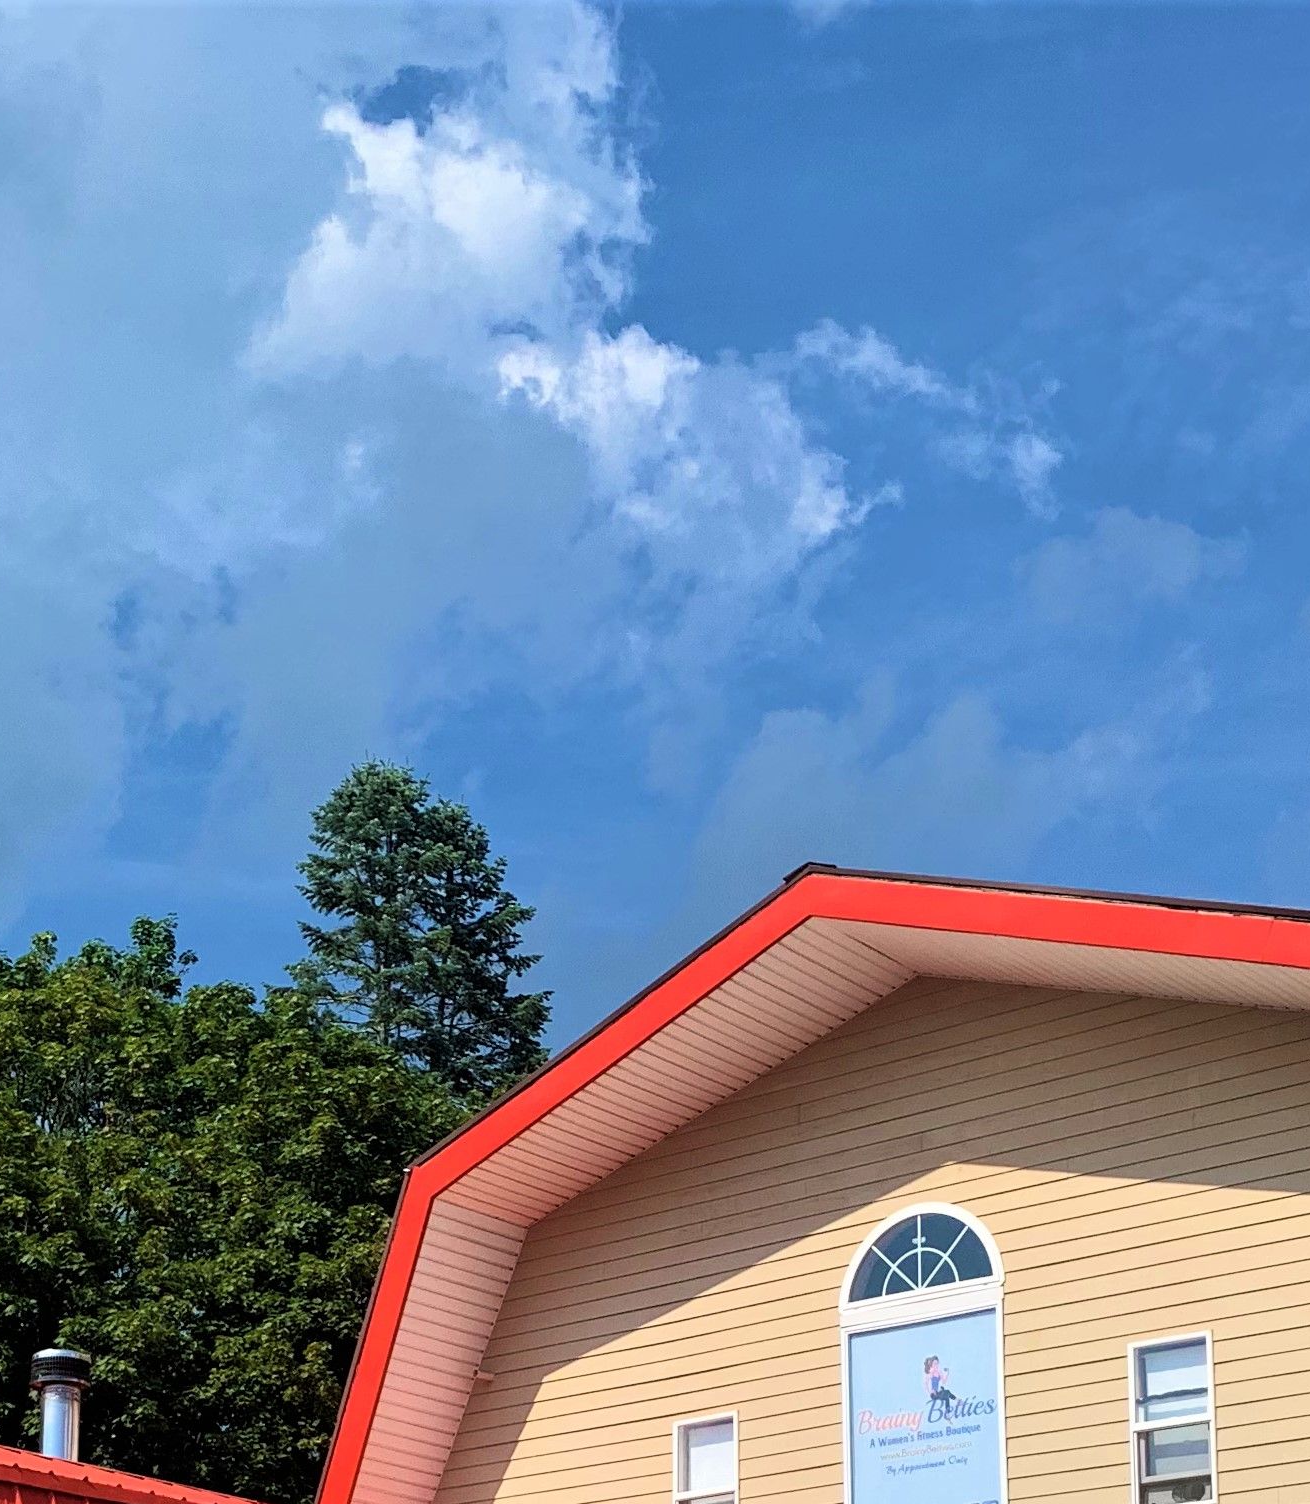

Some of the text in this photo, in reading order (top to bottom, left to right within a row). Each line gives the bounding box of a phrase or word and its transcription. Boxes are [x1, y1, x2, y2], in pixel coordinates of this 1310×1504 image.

[858, 1396, 995, 1434] Brainy Betties
[869, 1438, 876, 1449] A
[878, 1432, 915, 1447] Women's
[945, 1424, 982, 1438] Boutique
[948, 1455, 969, 1467] Only
